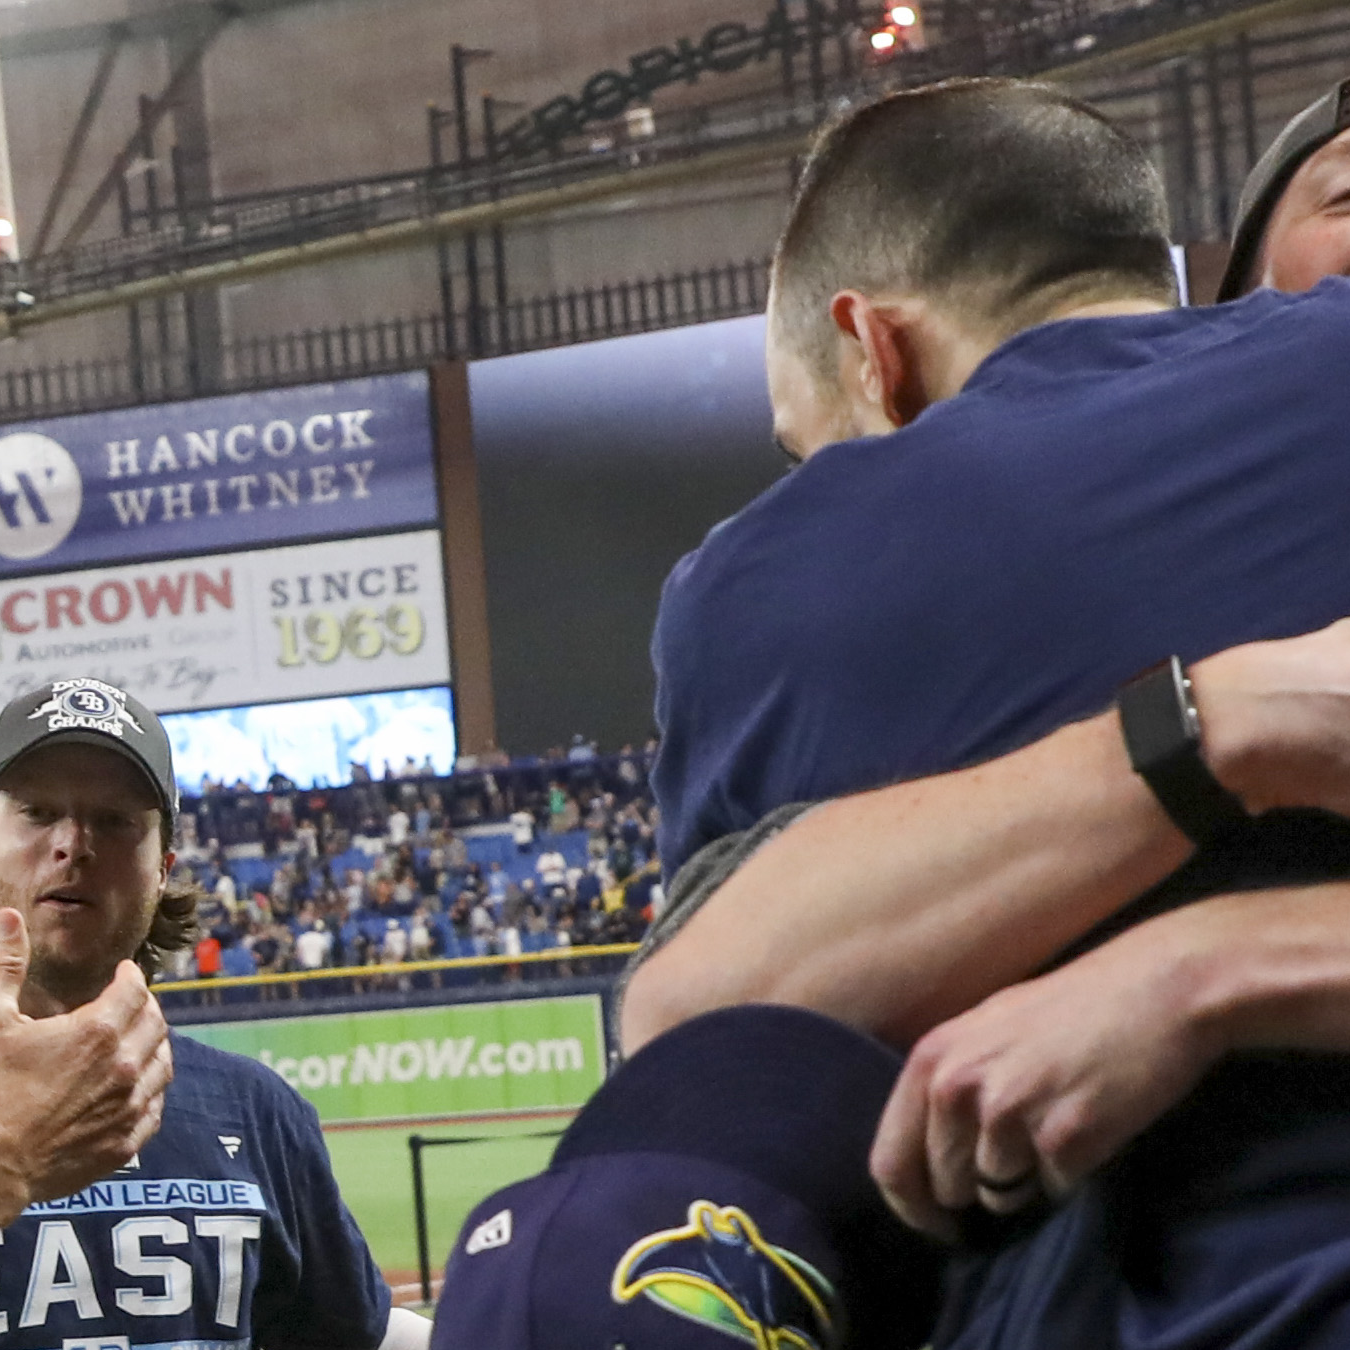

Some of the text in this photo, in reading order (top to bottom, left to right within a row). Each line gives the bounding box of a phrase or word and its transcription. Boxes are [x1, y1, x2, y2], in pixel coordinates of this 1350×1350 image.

[106, 408, 377, 479] HANCOCK
[107, 459, 376, 527] WHITNEY
[0, 568, 235, 635] CROWN
[269, 563, 419, 608] SINCE
[271, 603, 424, 669] 1969
[51, 678, 127, 703] DIVISION
[48, 714, 124, 736] CHAMPS
[123, 1182, 250, 1207] LEAGUE
